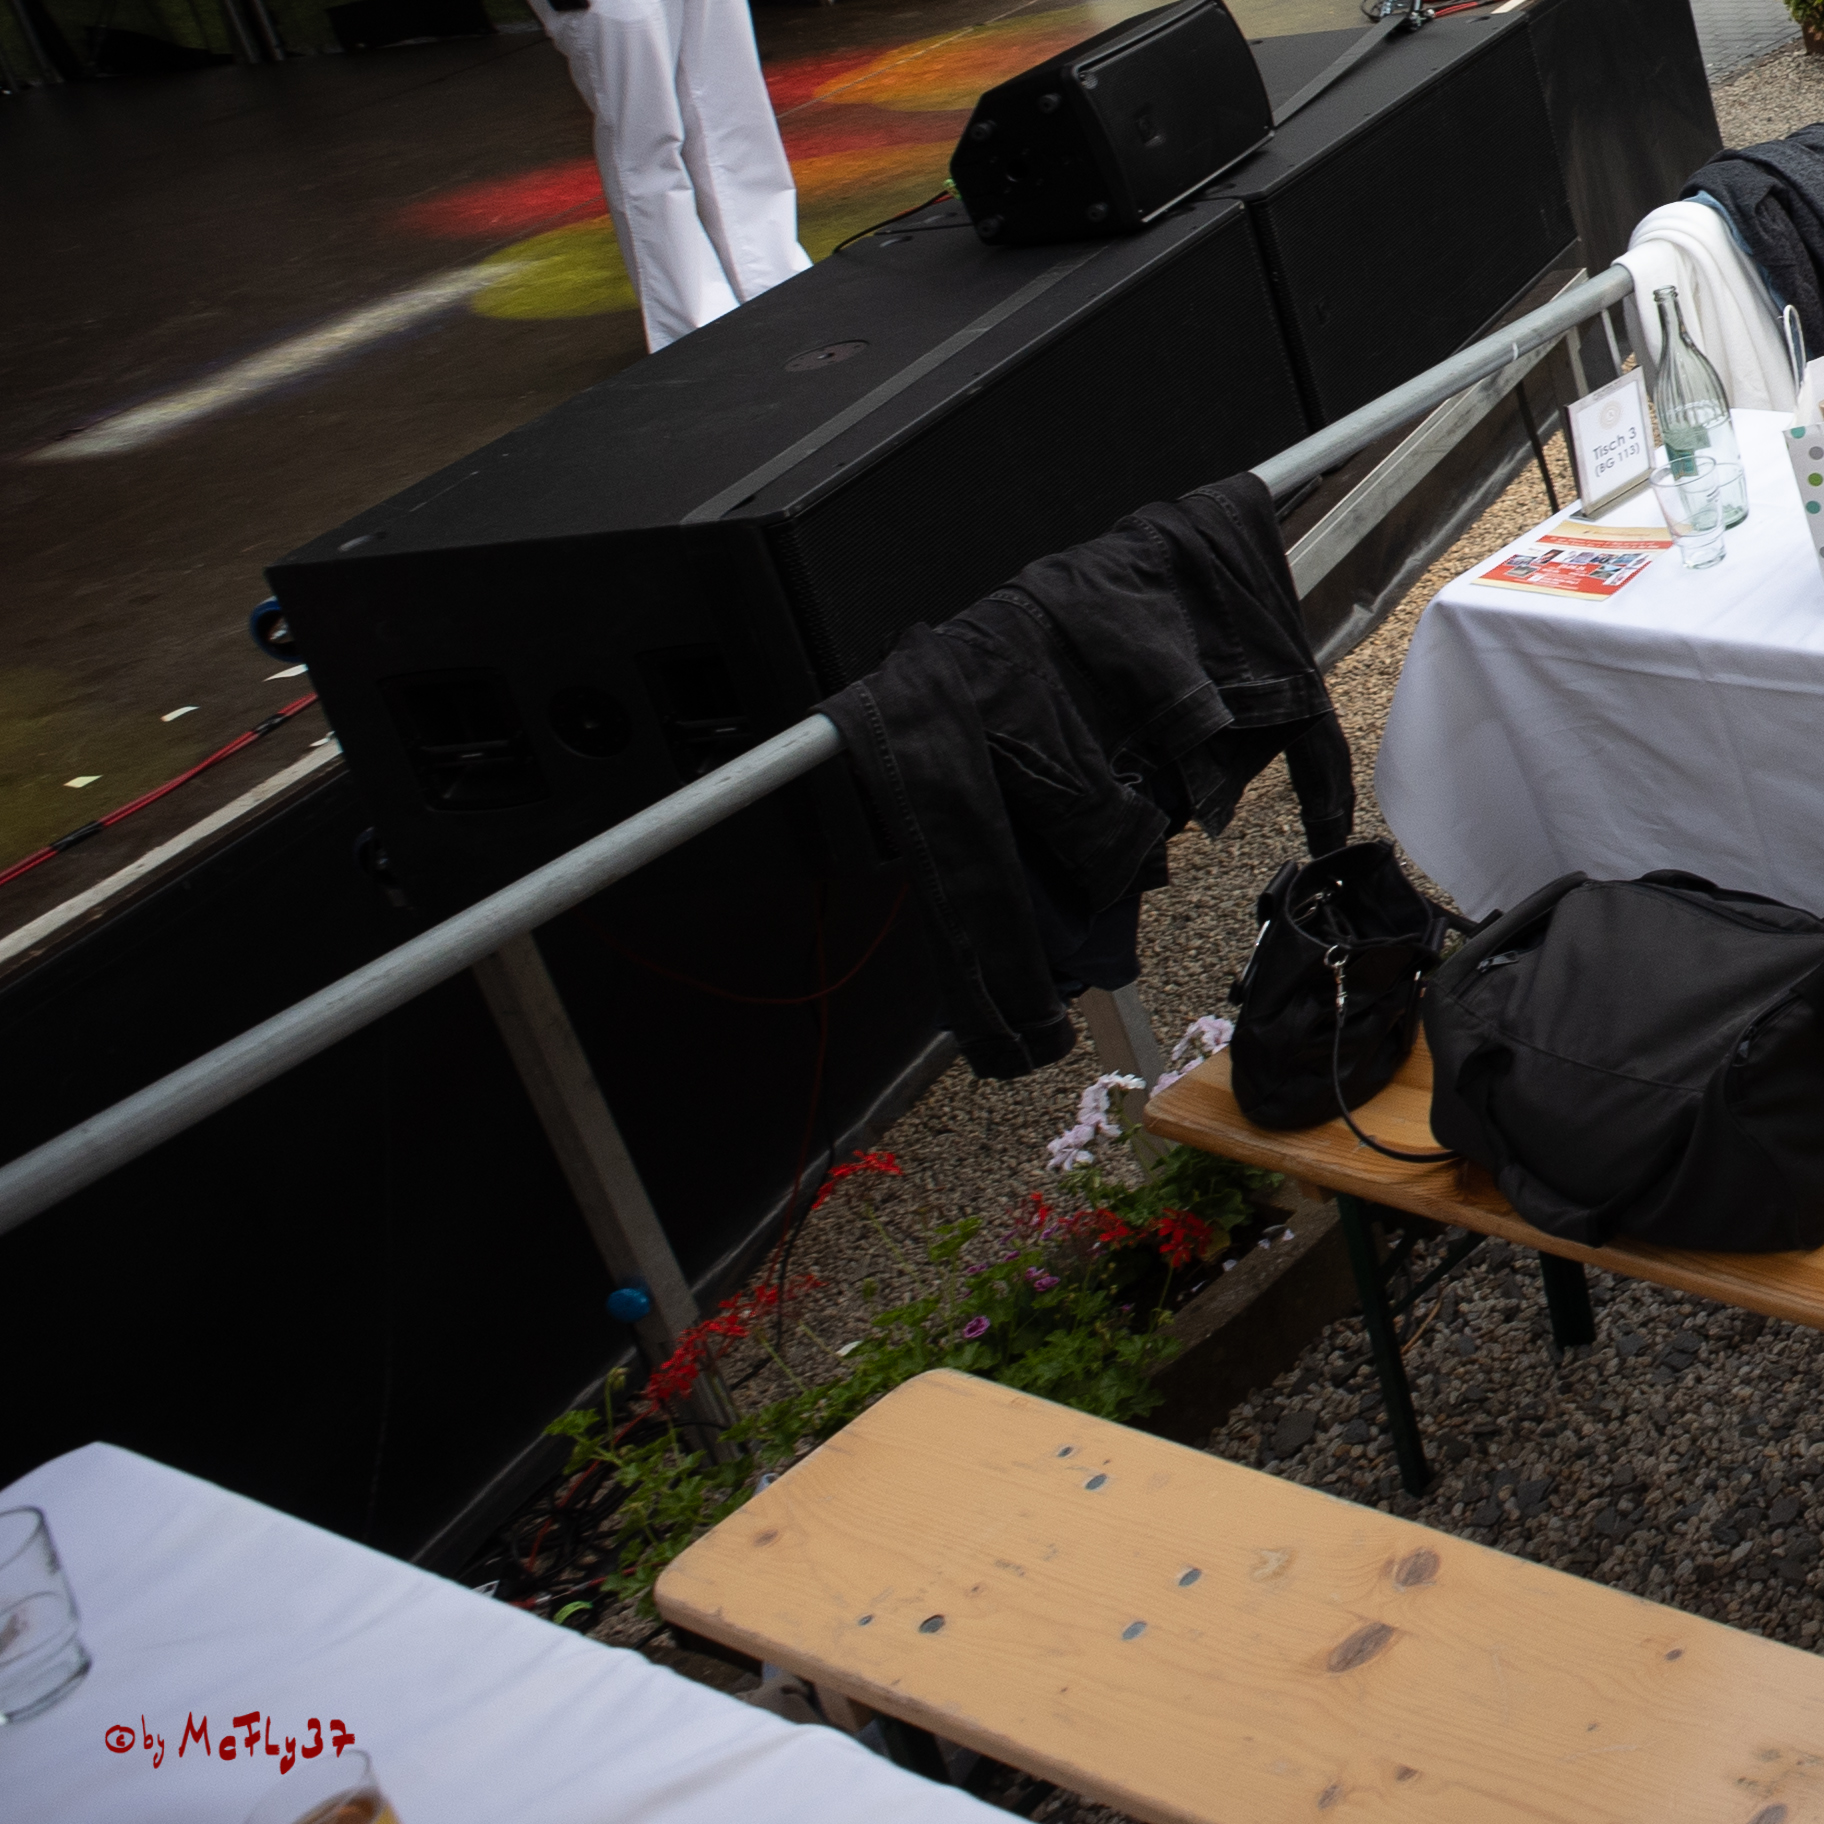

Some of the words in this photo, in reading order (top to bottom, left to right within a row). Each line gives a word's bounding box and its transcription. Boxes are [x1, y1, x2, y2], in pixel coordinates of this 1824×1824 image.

[1592, 435, 1626, 460] Tisch
[1628, 426, 1637, 439] 3
[1594, 457, 1616, 478] (BG
[1618, 442, 1640, 462] 113)
